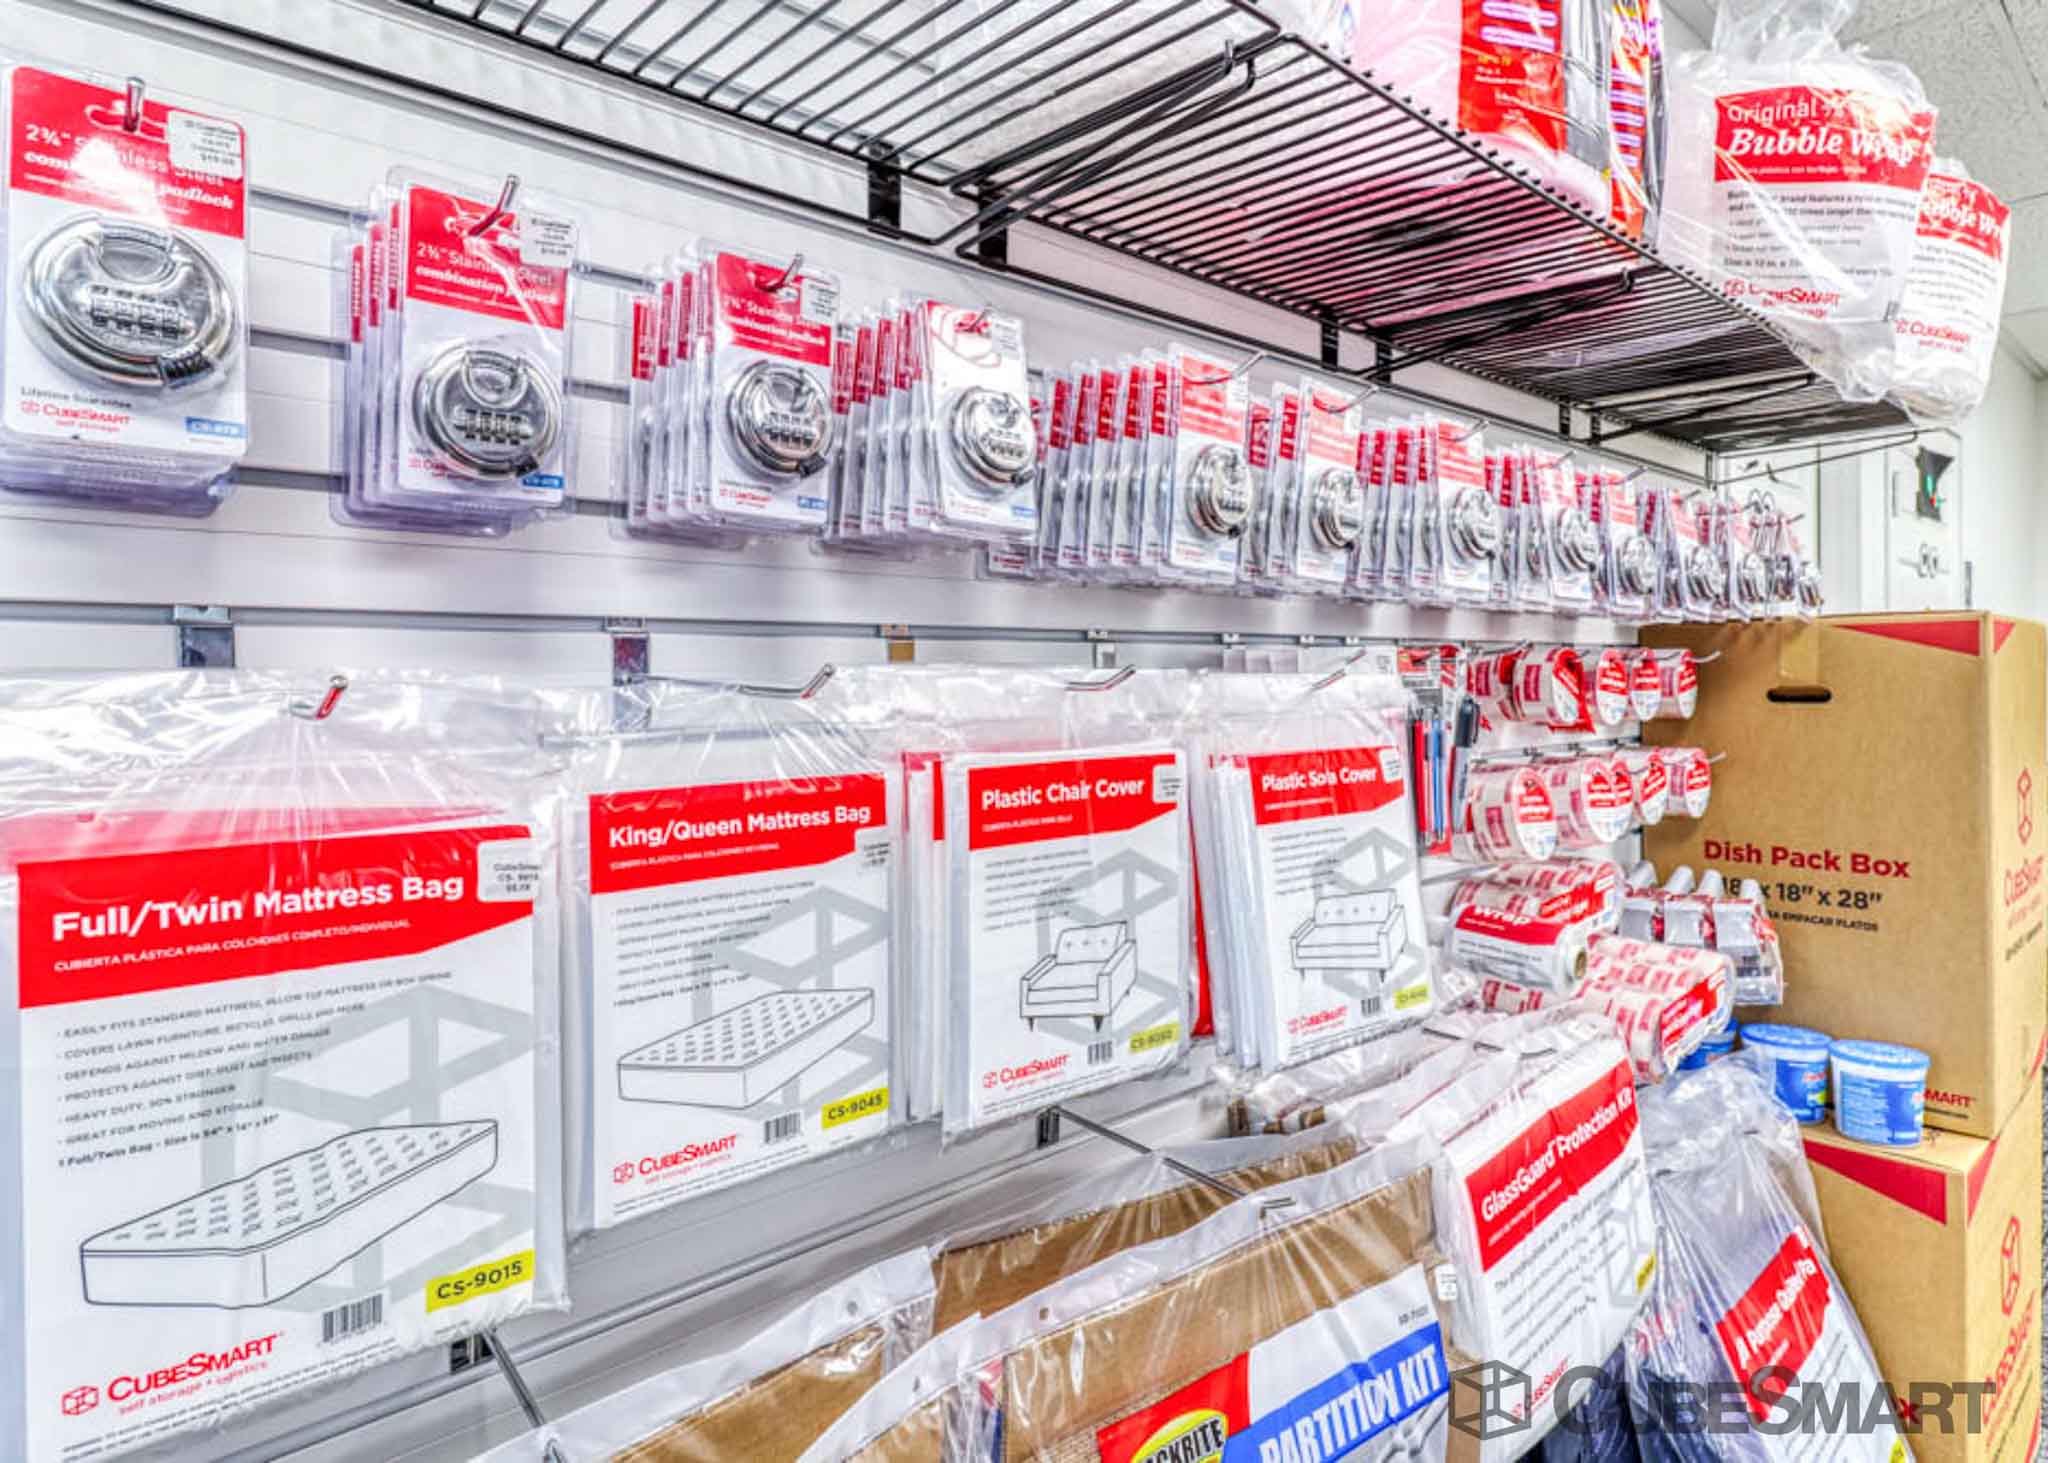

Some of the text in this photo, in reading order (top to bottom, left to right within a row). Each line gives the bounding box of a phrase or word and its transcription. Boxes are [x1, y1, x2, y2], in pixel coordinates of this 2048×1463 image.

[1727, 97, 1818, 128] Original
[1727, 127, 1843, 157] Bubble
[981, 787, 1043, 811] Plastic
[1046, 780, 1091, 803] Chair
[1095, 778, 1145, 798] Cover
[1262, 771, 1308, 793] Plastic
[1339, 766, 1378, 783] Cover
[609, 805, 871, 849] King/Queen Mattress Bag
[1704, 839, 1911, 879] Dish Pack Box
[52, 875, 464, 943] Full/Twin Mattress Bag
[1819, 891, 1831, 907] x
[54, 954, 120, 972] CUBIERTA
[186, 941, 220, 954] PARA
[64, 1043, 114, 1060] COVERS
[64, 1064, 121, 1081] DEFENDS
[125, 1054, 176, 1071] AGAINST
[64, 1085, 129, 1103] PROTECTS
[132, 1073, 182, 1091] AGAINST
[65, 1109, 107, 1124] HEAVY
[65, 1131, 107, 1146] GREAT
[639, 1134, 737, 1176] CUBESMART
[437, 1259, 524, 1301] CS-9015
[108, 1333, 279, 1402] CUBESMART
[1259, 1372, 1397, 1463] PARTITION
[1398, 1344, 1443, 1408] KIT
